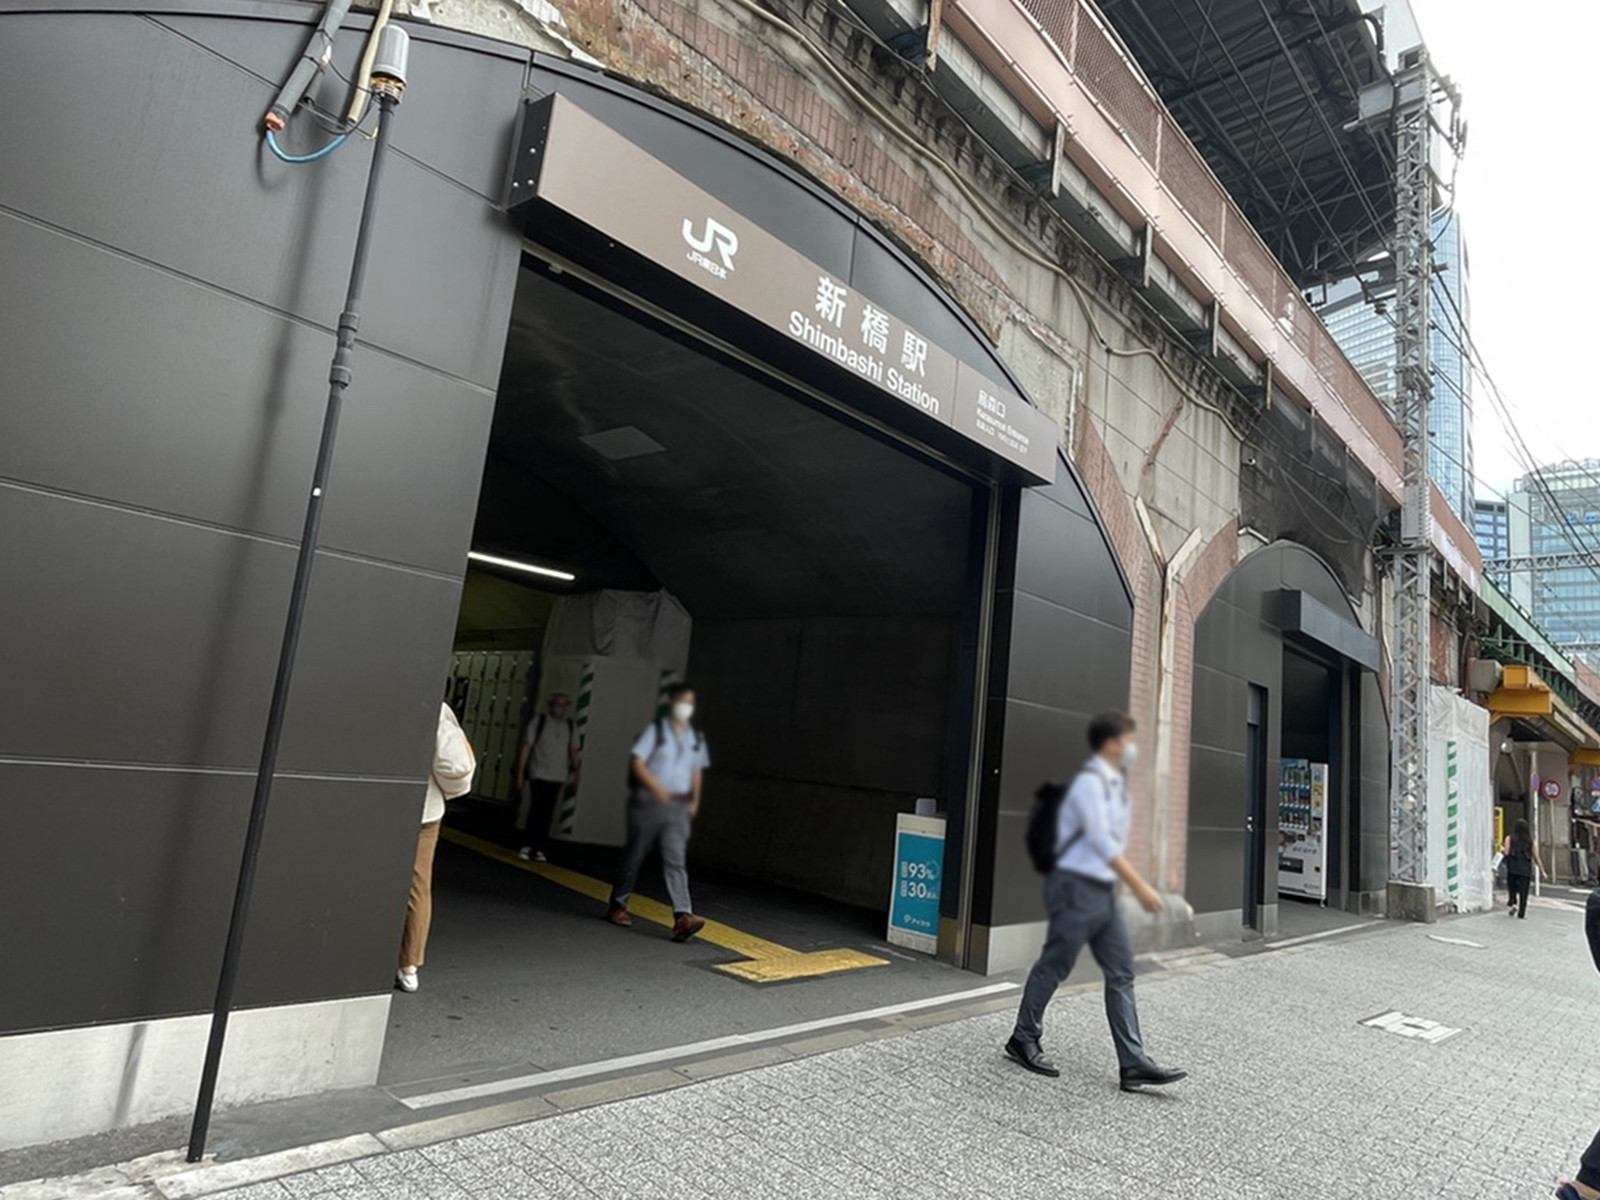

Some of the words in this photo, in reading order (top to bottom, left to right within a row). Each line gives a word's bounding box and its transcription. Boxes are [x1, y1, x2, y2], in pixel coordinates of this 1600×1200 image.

[682, 217, 738, 272] JR
[789, 310, 883, 382] Shimbashi
[886, 368, 940, 415] Station
[815, 276, 928, 377] 新橋駅
